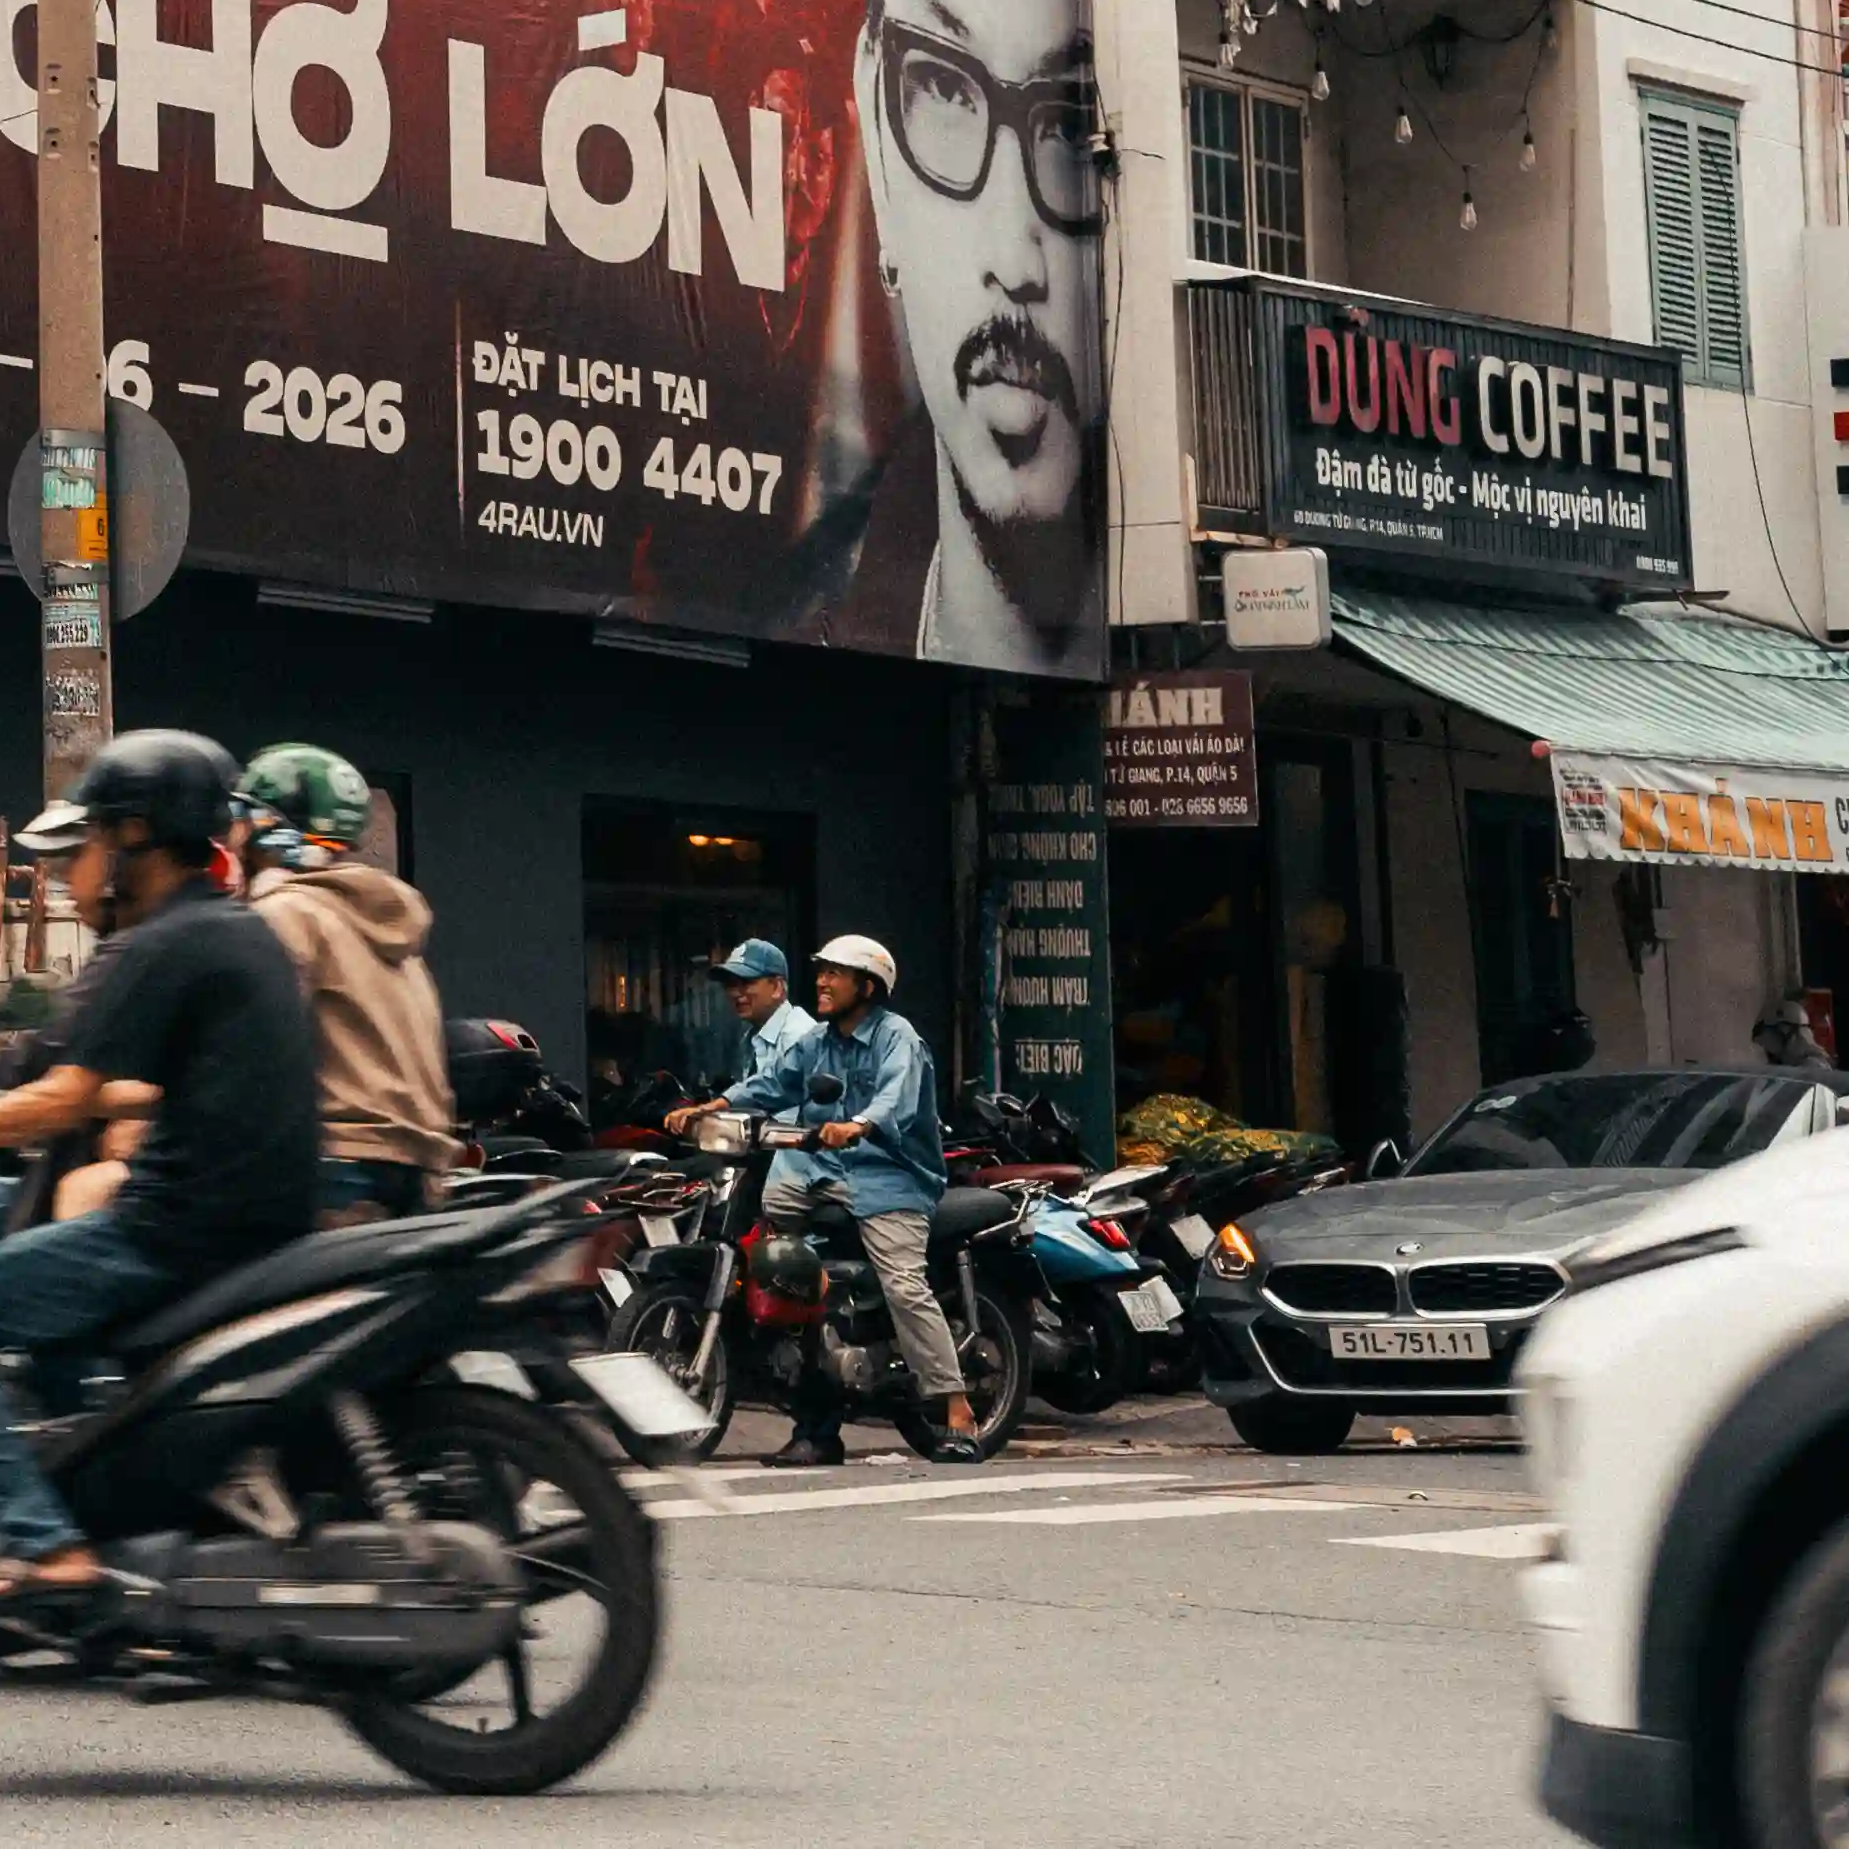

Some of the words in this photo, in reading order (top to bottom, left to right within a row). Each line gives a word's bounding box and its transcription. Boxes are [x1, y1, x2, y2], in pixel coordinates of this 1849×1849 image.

[448, 7, 786, 292] LỚN
[103, 340, 155, 413] 6
[243, 359, 406, 455] 2026
[472, 329, 544, 399] ĐẶT
[558, 357, 642, 409] LỊCH
[651, 372, 708, 429] TẠI
[1477, 353, 1674, 480] COFFEE
[476, 408, 623, 493] 1900
[643, 437, 783, 517] 4407
[1316, 447, 1363, 498] Đậm
[1366, 448, 1392, 496] đà
[1395, 458, 1418, 499] từ
[1422, 456, 1456, 511] gốc
[1472, 470, 1511, 519] Mộc
[1514, 476, 1533, 523] vị
[1537, 485, 1604, 531] nguyên
[1606, 489, 1647, 531] khai
[477, 500, 606, 549] 4RAU.VN
[1341, 1328, 1474, 1355] 51L-751.11
